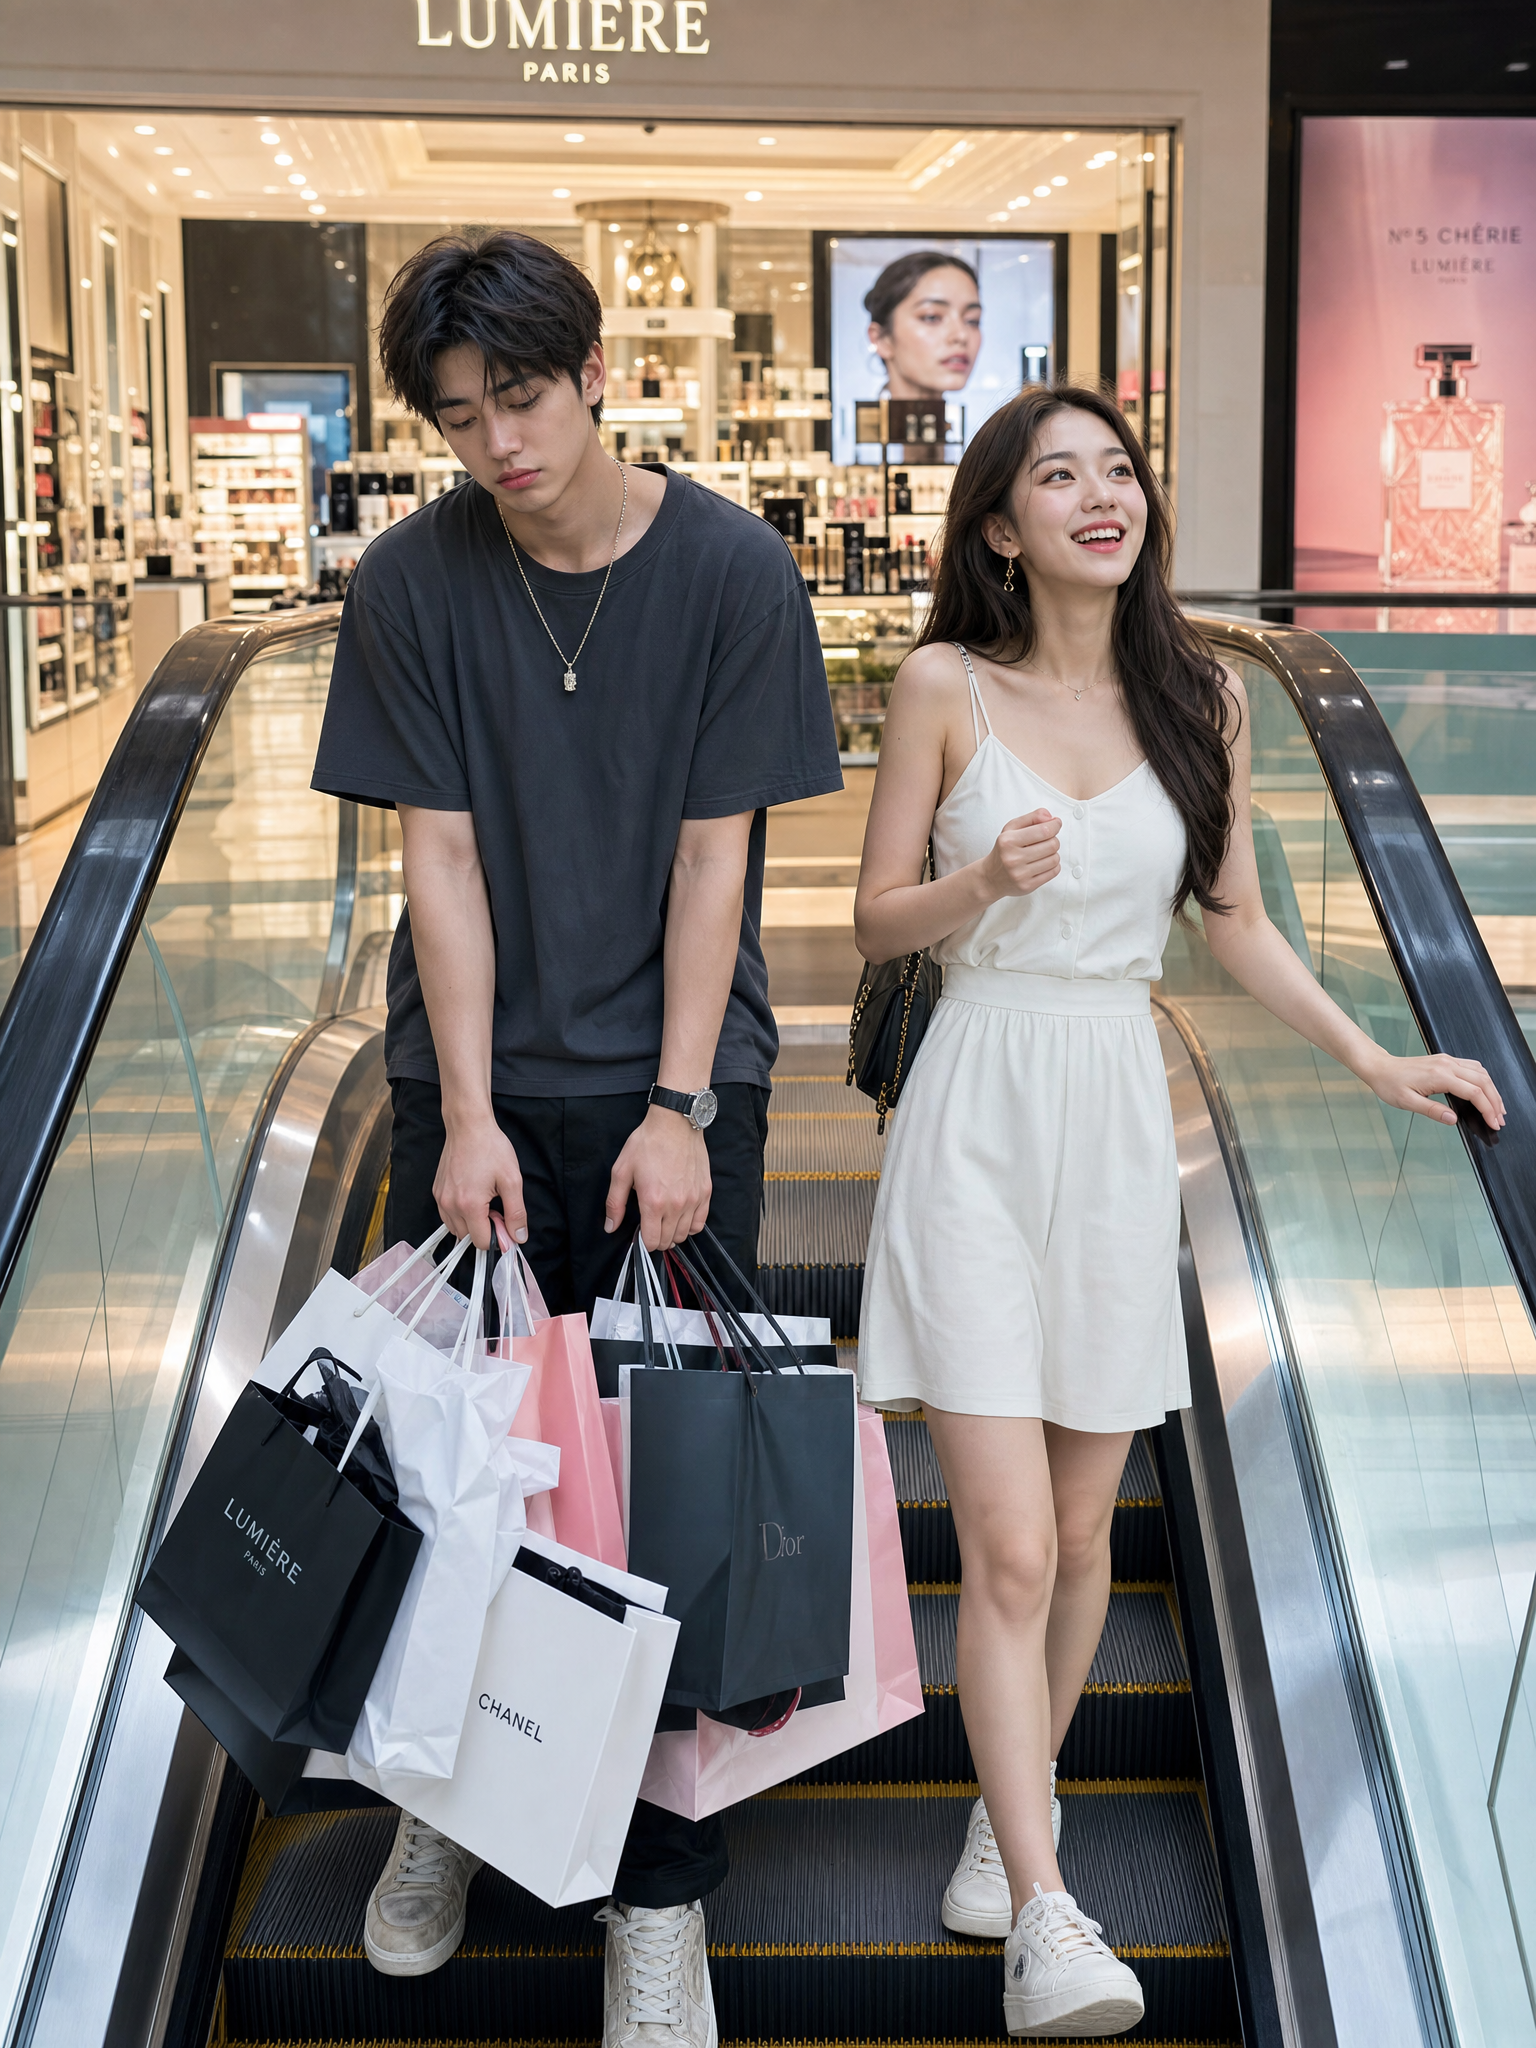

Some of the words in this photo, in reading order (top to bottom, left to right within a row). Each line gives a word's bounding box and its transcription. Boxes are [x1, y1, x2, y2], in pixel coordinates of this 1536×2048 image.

[523, 61, 611, 84] PARIS
[1436, 221, 1523, 245] CHÉRIE
[758, 1521, 805, 1562] Dior
[243, 1550, 267, 1576] PARIS
[478, 1693, 543, 1743] CHANEL
